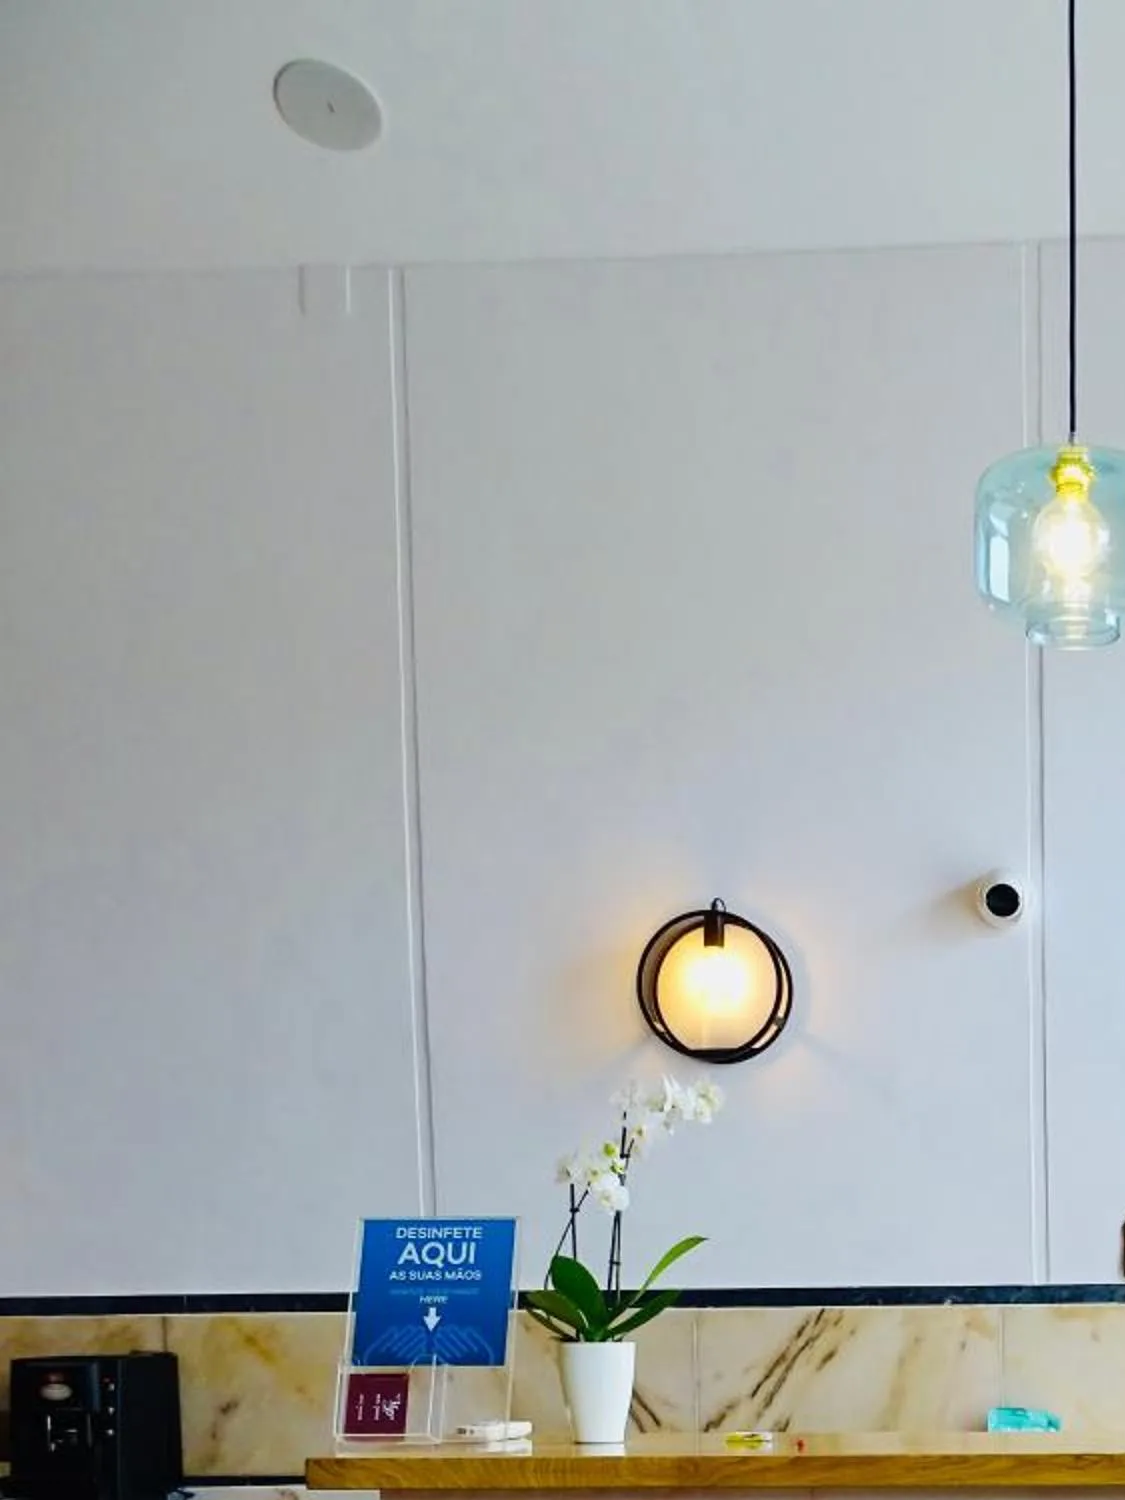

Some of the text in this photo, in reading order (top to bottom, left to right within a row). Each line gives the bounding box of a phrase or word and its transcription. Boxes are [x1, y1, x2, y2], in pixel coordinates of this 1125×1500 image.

[396, 1226, 483, 1239] DESINFETE
[397, 1241, 477, 1268] AQUI
[389, 1267, 482, 1281] AS SUAS MÃOS
